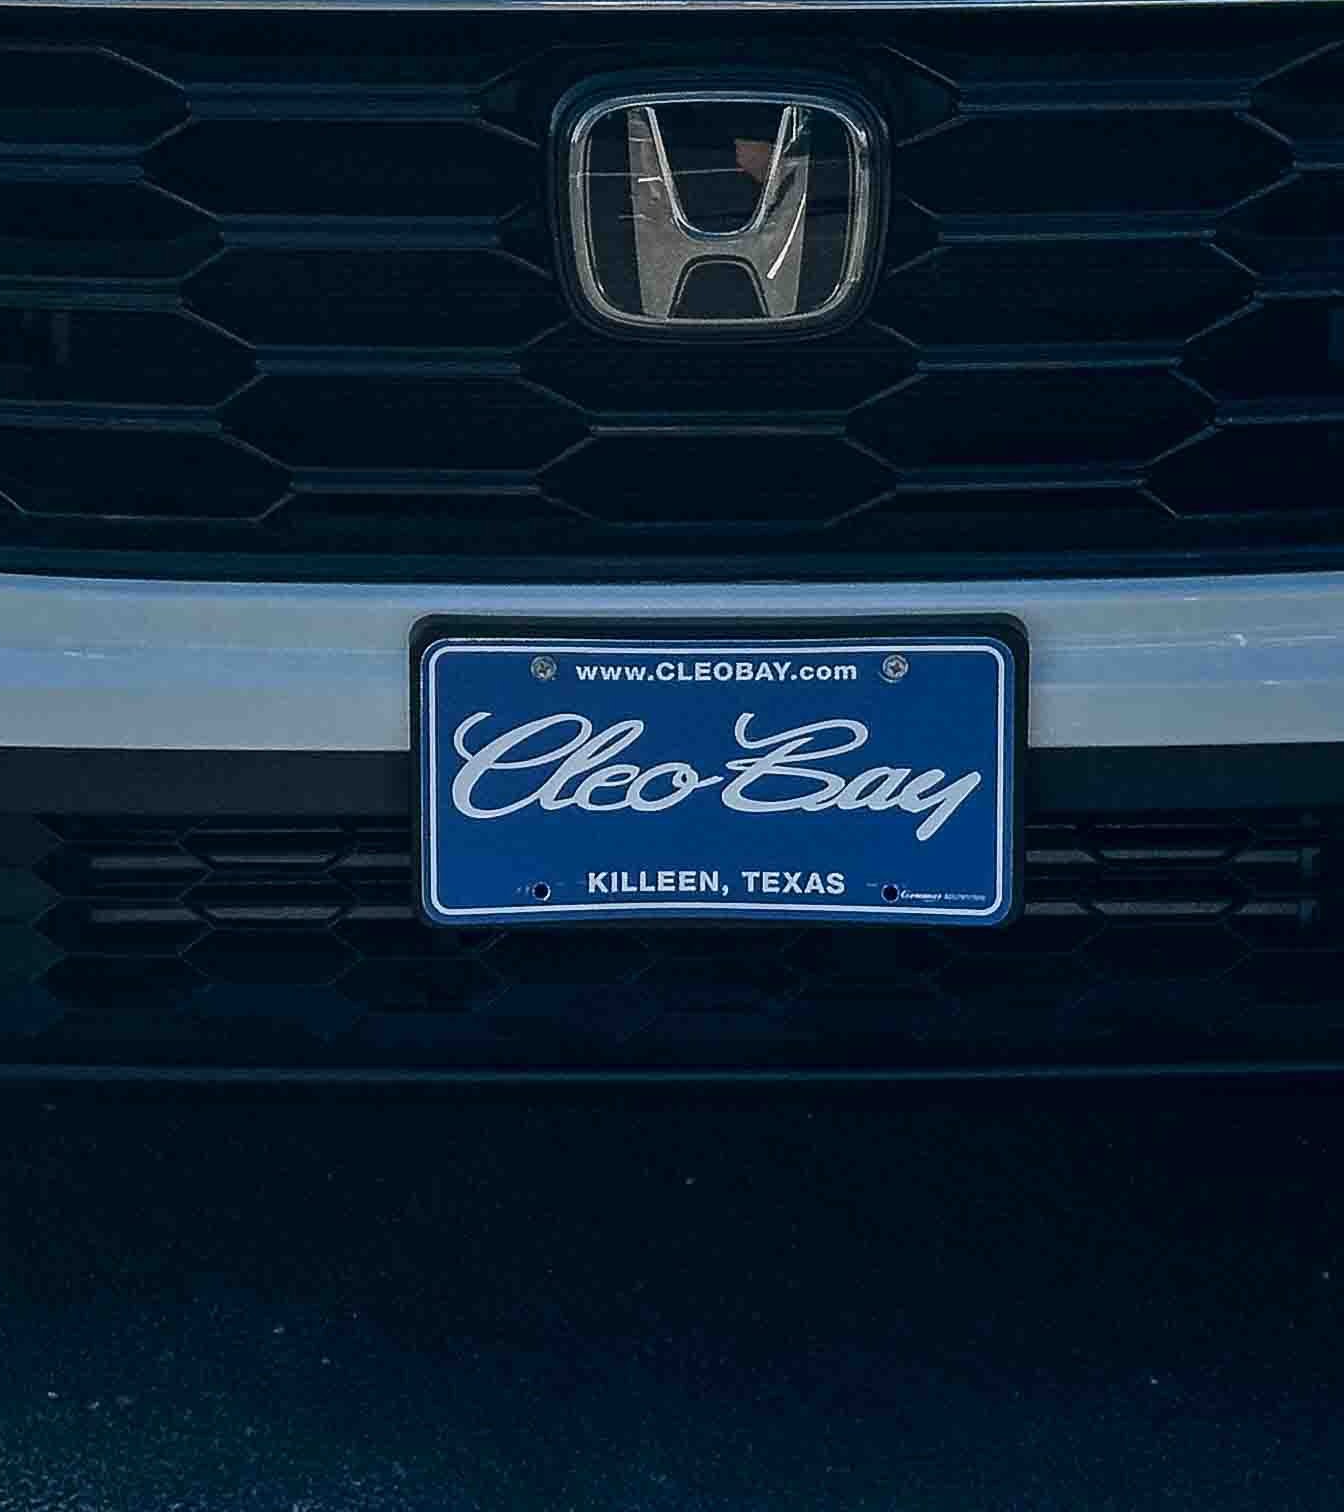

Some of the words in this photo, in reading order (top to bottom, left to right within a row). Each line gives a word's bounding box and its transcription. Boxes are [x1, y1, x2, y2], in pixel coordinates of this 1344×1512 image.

[575, 661, 857, 682] www.CLEOBAY.com
[451, 711, 724, 819] Cleo
[721, 712, 982, 841] Bay
[587, 870, 729, 897] KILLEEN,
[741, 870, 846, 895] TEXAS
